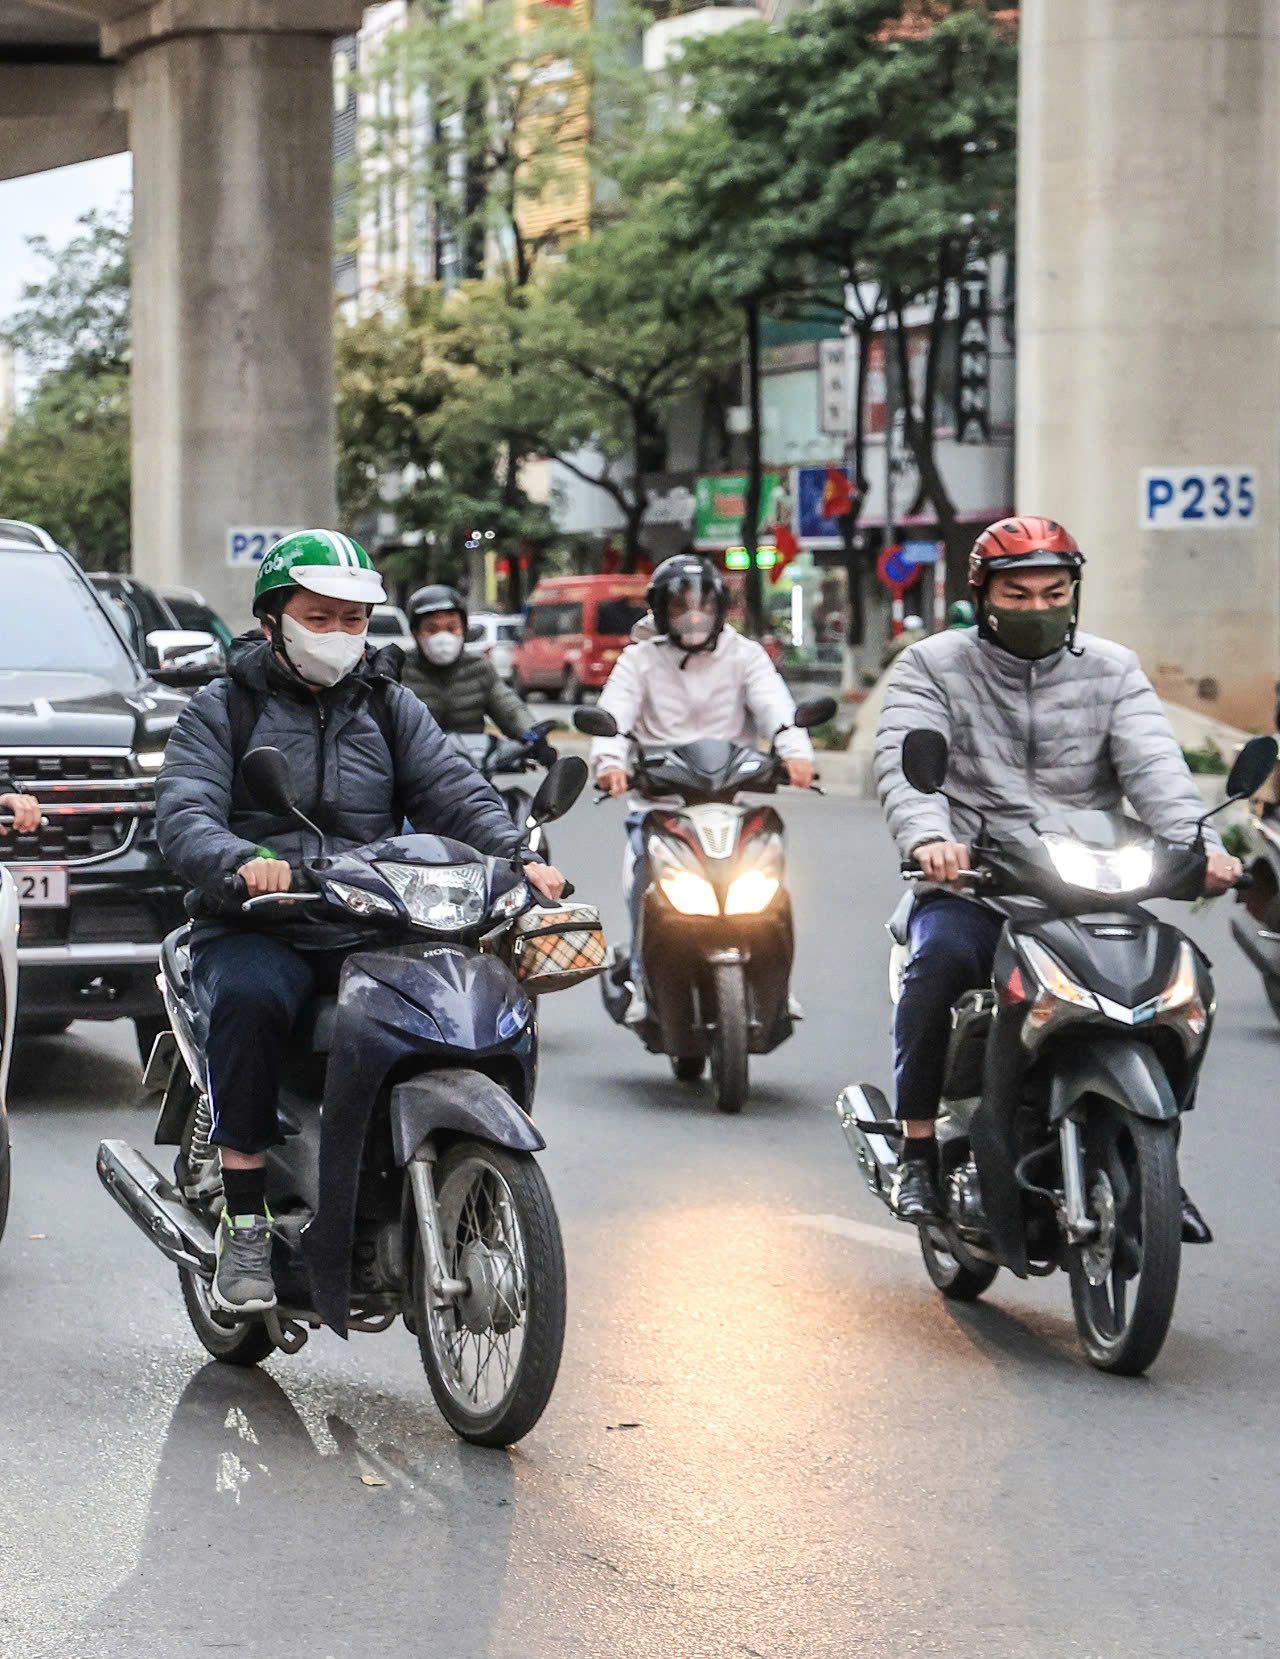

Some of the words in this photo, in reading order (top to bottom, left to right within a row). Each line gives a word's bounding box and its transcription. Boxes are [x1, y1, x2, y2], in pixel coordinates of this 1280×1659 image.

[1147, 476, 1254, 519] P235
[232, 533, 281, 560] P2
[22, 876, 48, 898] 21
